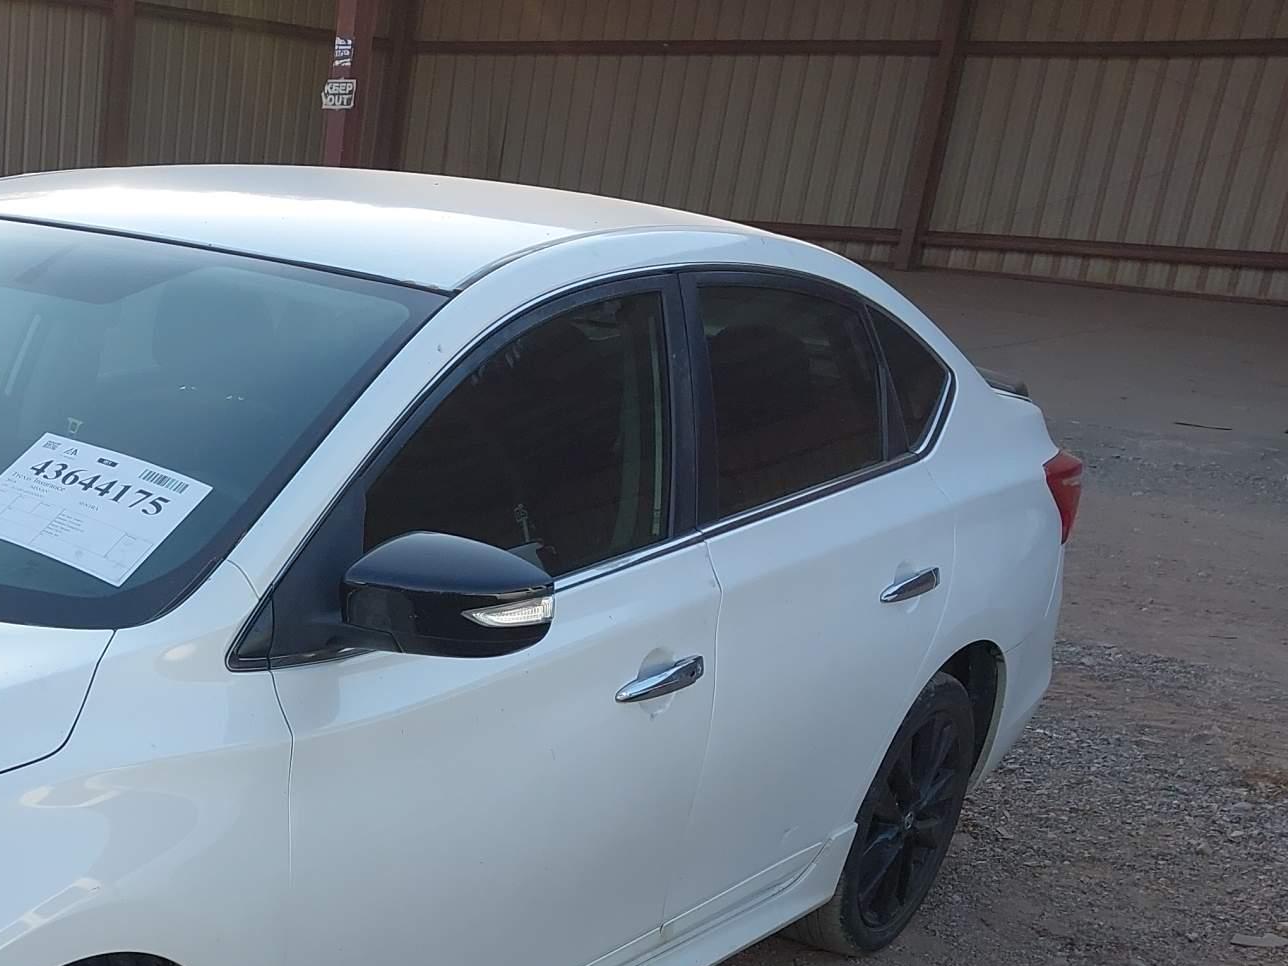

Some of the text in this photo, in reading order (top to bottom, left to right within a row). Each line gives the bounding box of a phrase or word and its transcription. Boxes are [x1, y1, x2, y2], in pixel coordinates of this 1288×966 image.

[327, 83, 353, 94] KEEP
[326, 95, 351, 106] OUT
[30, 459, 171, 516] 43644175
